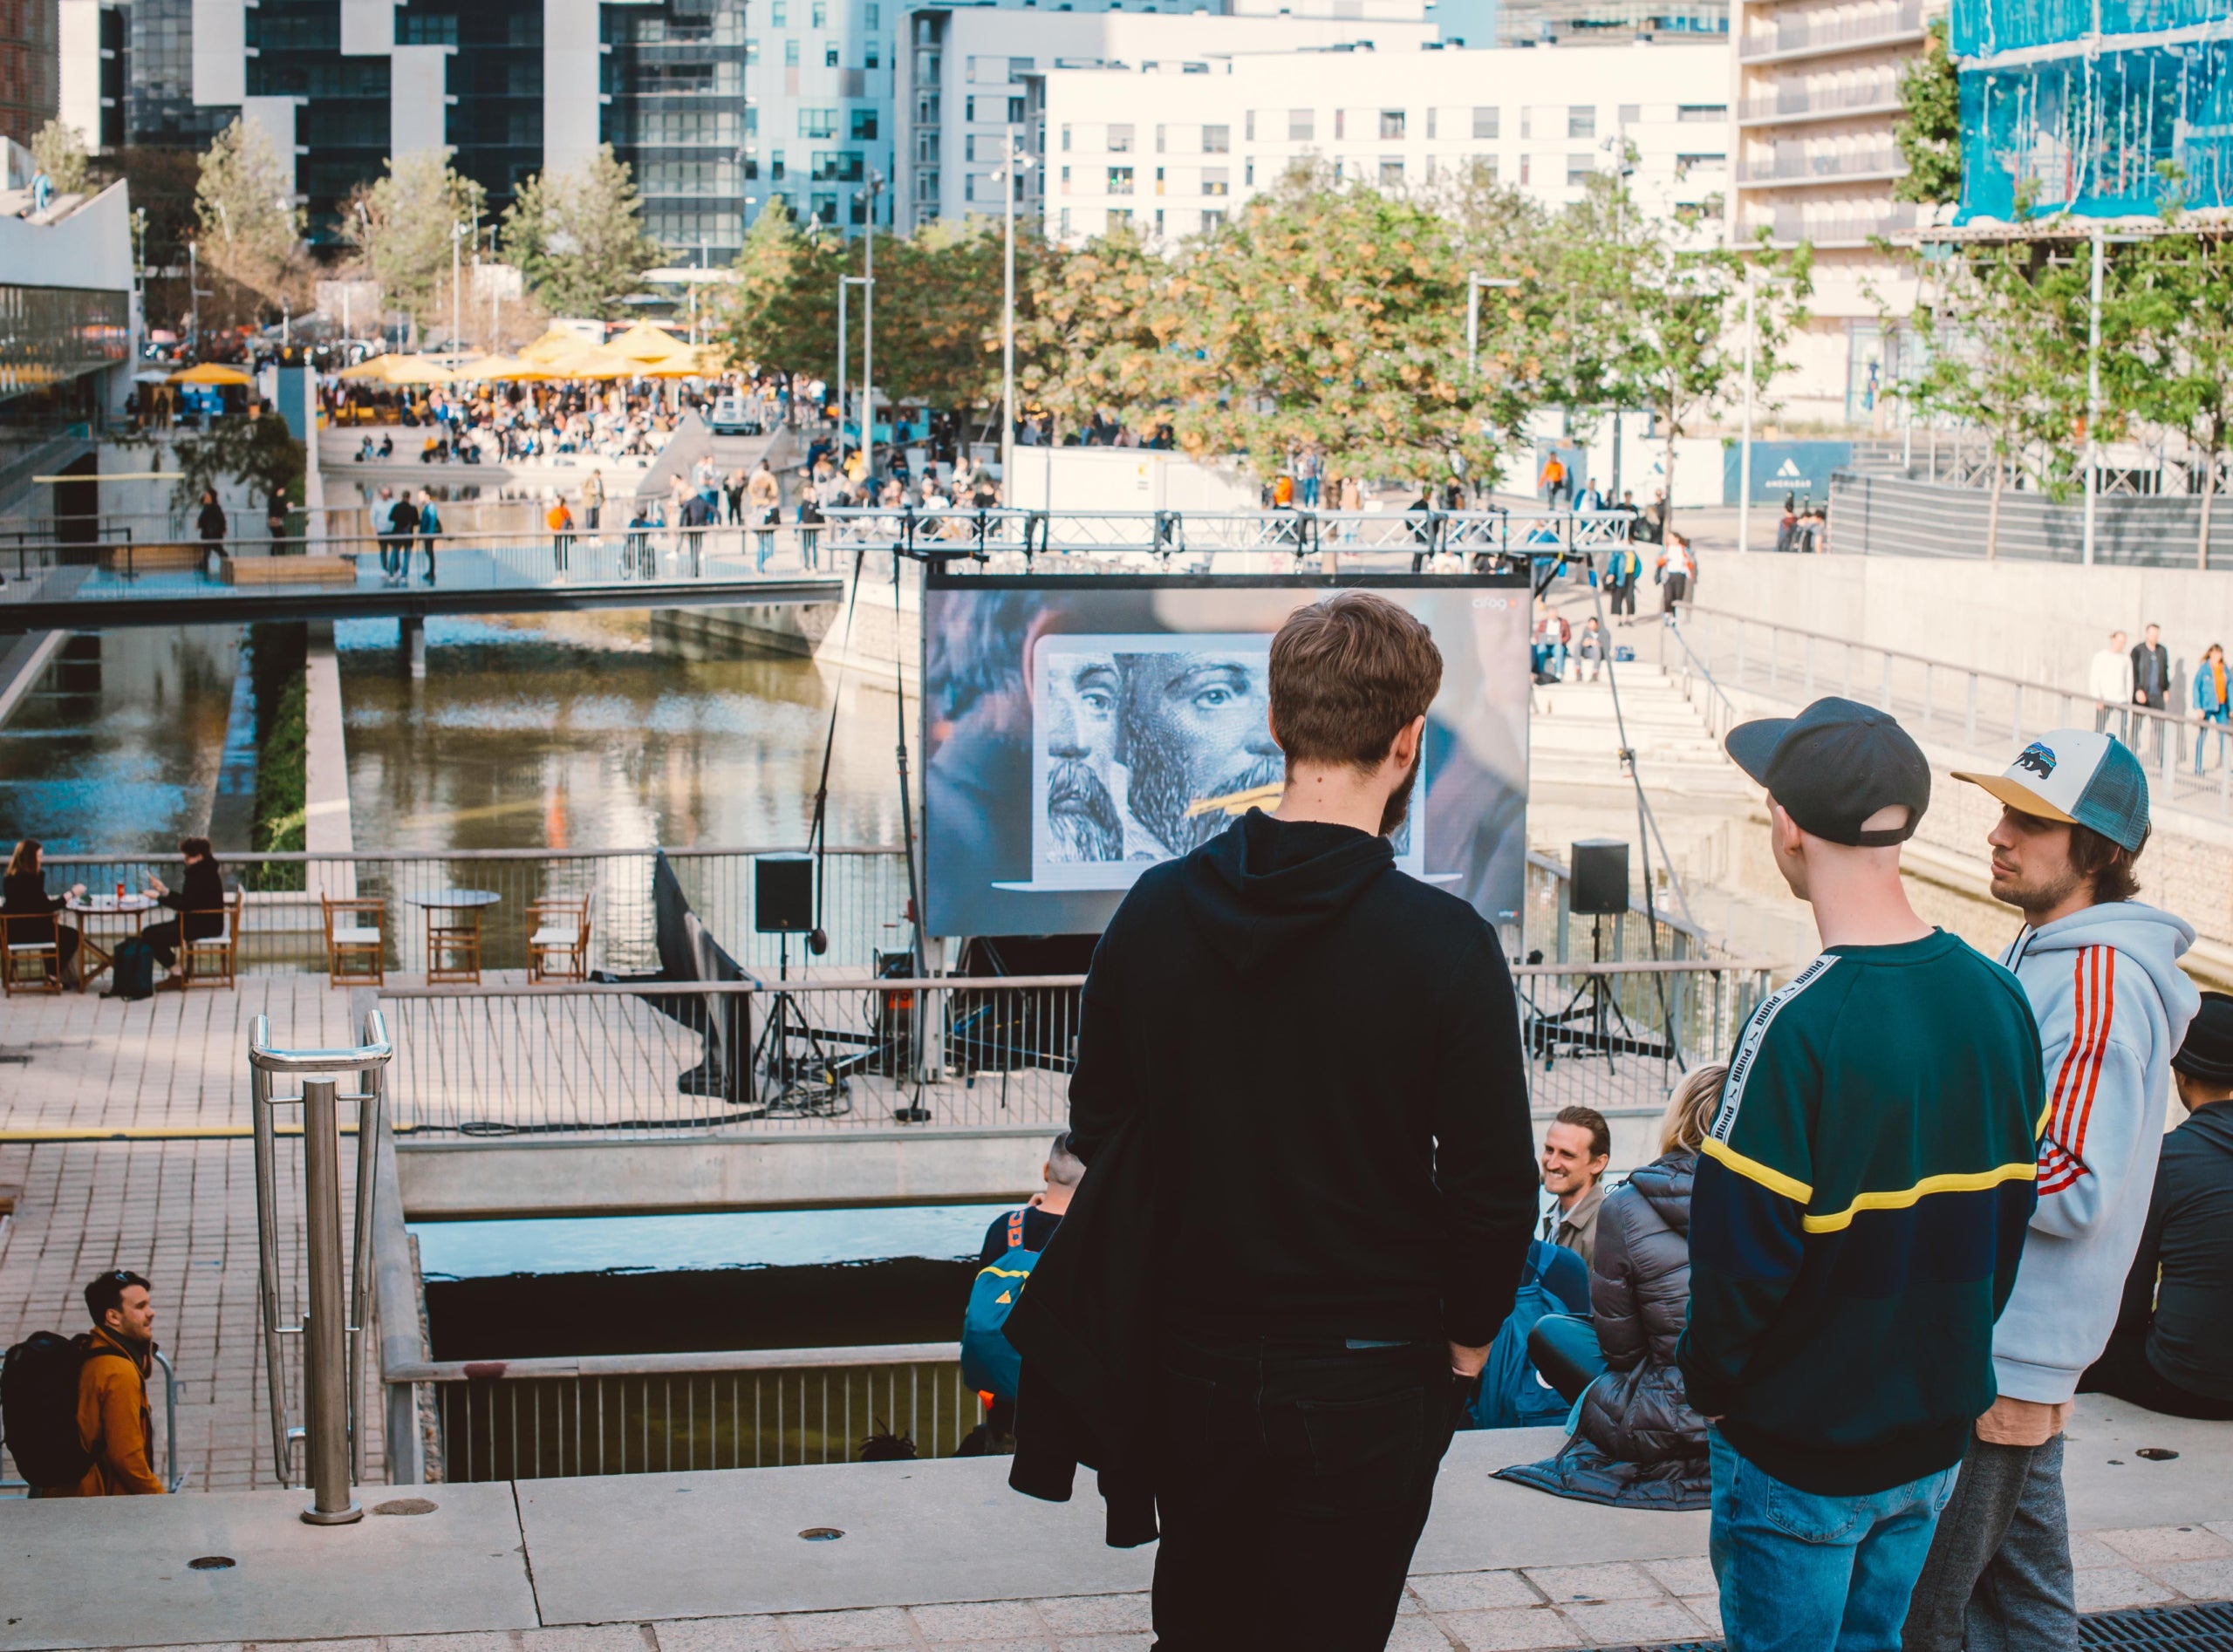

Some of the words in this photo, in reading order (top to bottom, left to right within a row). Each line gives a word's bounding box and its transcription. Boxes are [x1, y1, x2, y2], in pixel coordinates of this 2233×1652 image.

[1794, 960, 1825, 984] PUMA
[1754, 995, 1781, 1026] PUMA
[1732, 1048, 1752, 1082] PUMA
[1715, 1105, 1734, 1140] PUMA
